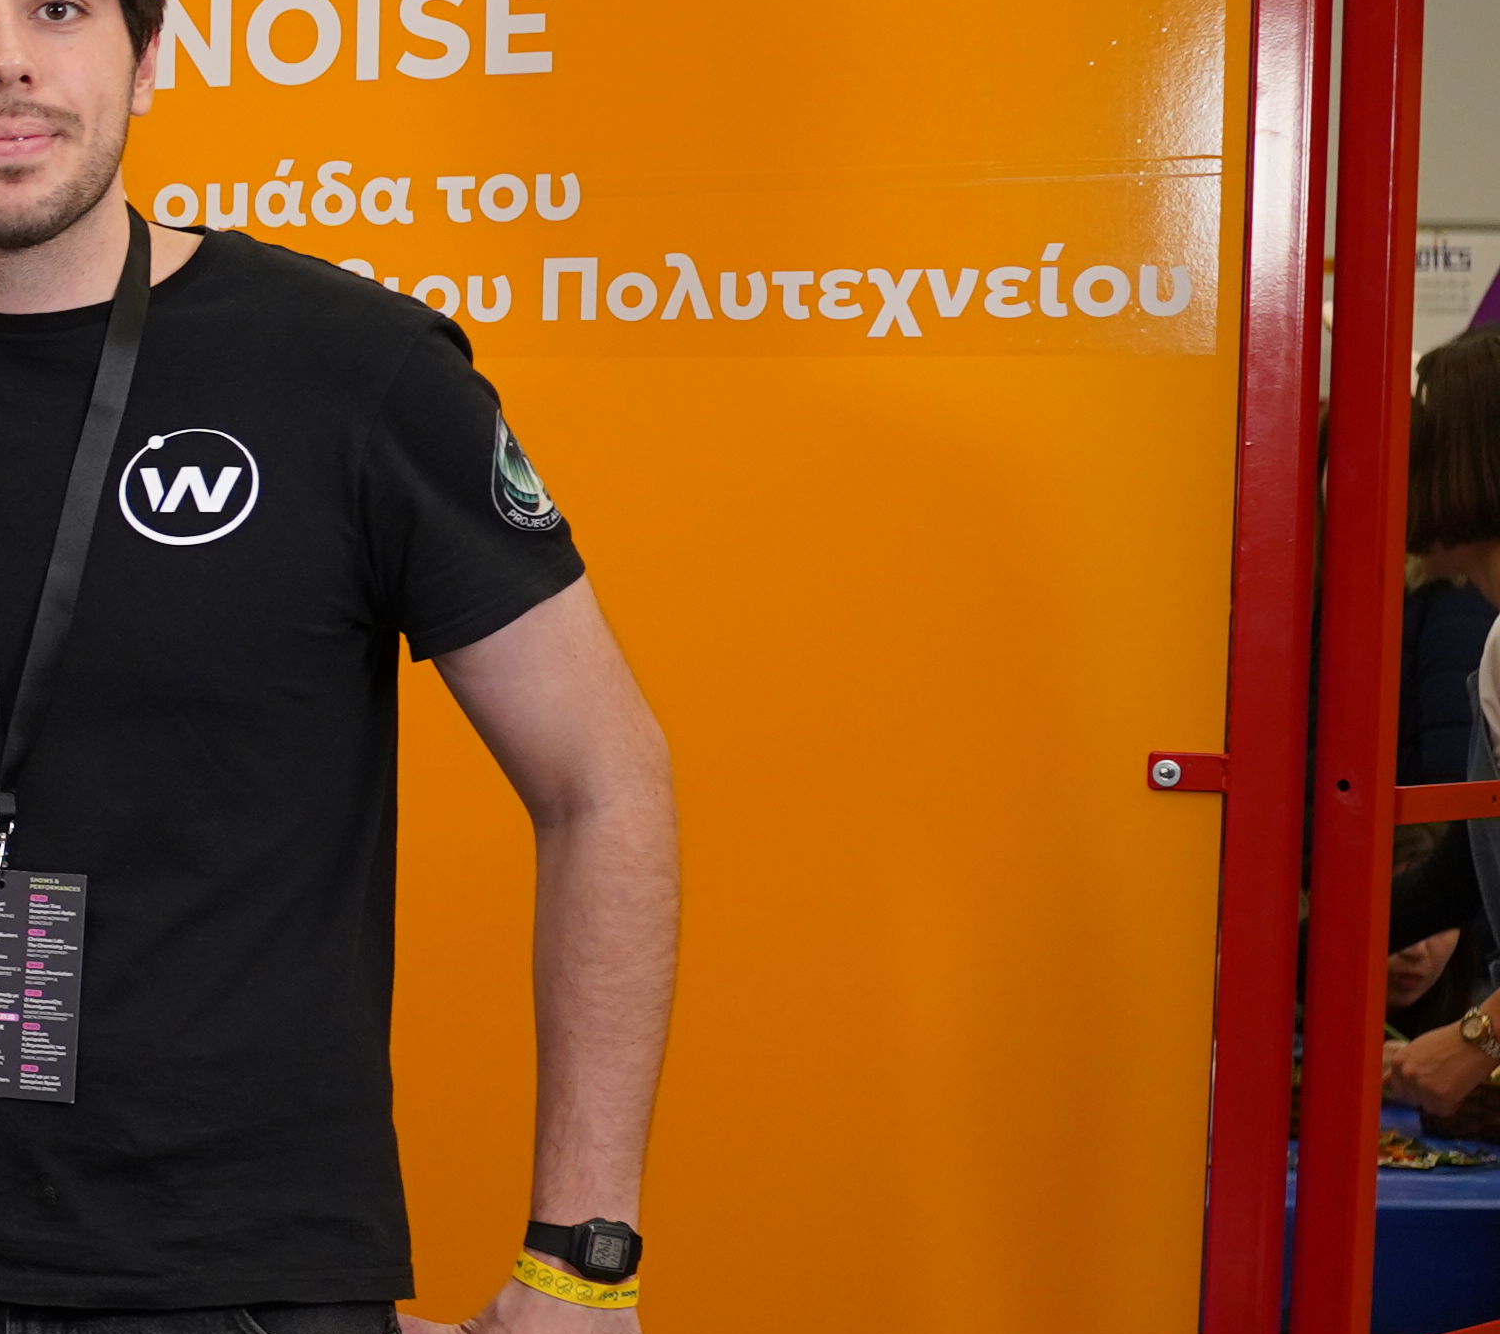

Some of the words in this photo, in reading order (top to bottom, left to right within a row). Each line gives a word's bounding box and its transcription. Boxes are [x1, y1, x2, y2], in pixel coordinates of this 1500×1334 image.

[152, 159, 414, 230] ομάδα
[436, 172, 582, 225] του
[540, 242, 1192, 341] Πολυτεχνείου
[506, 508, 551, 529] PROJECT
